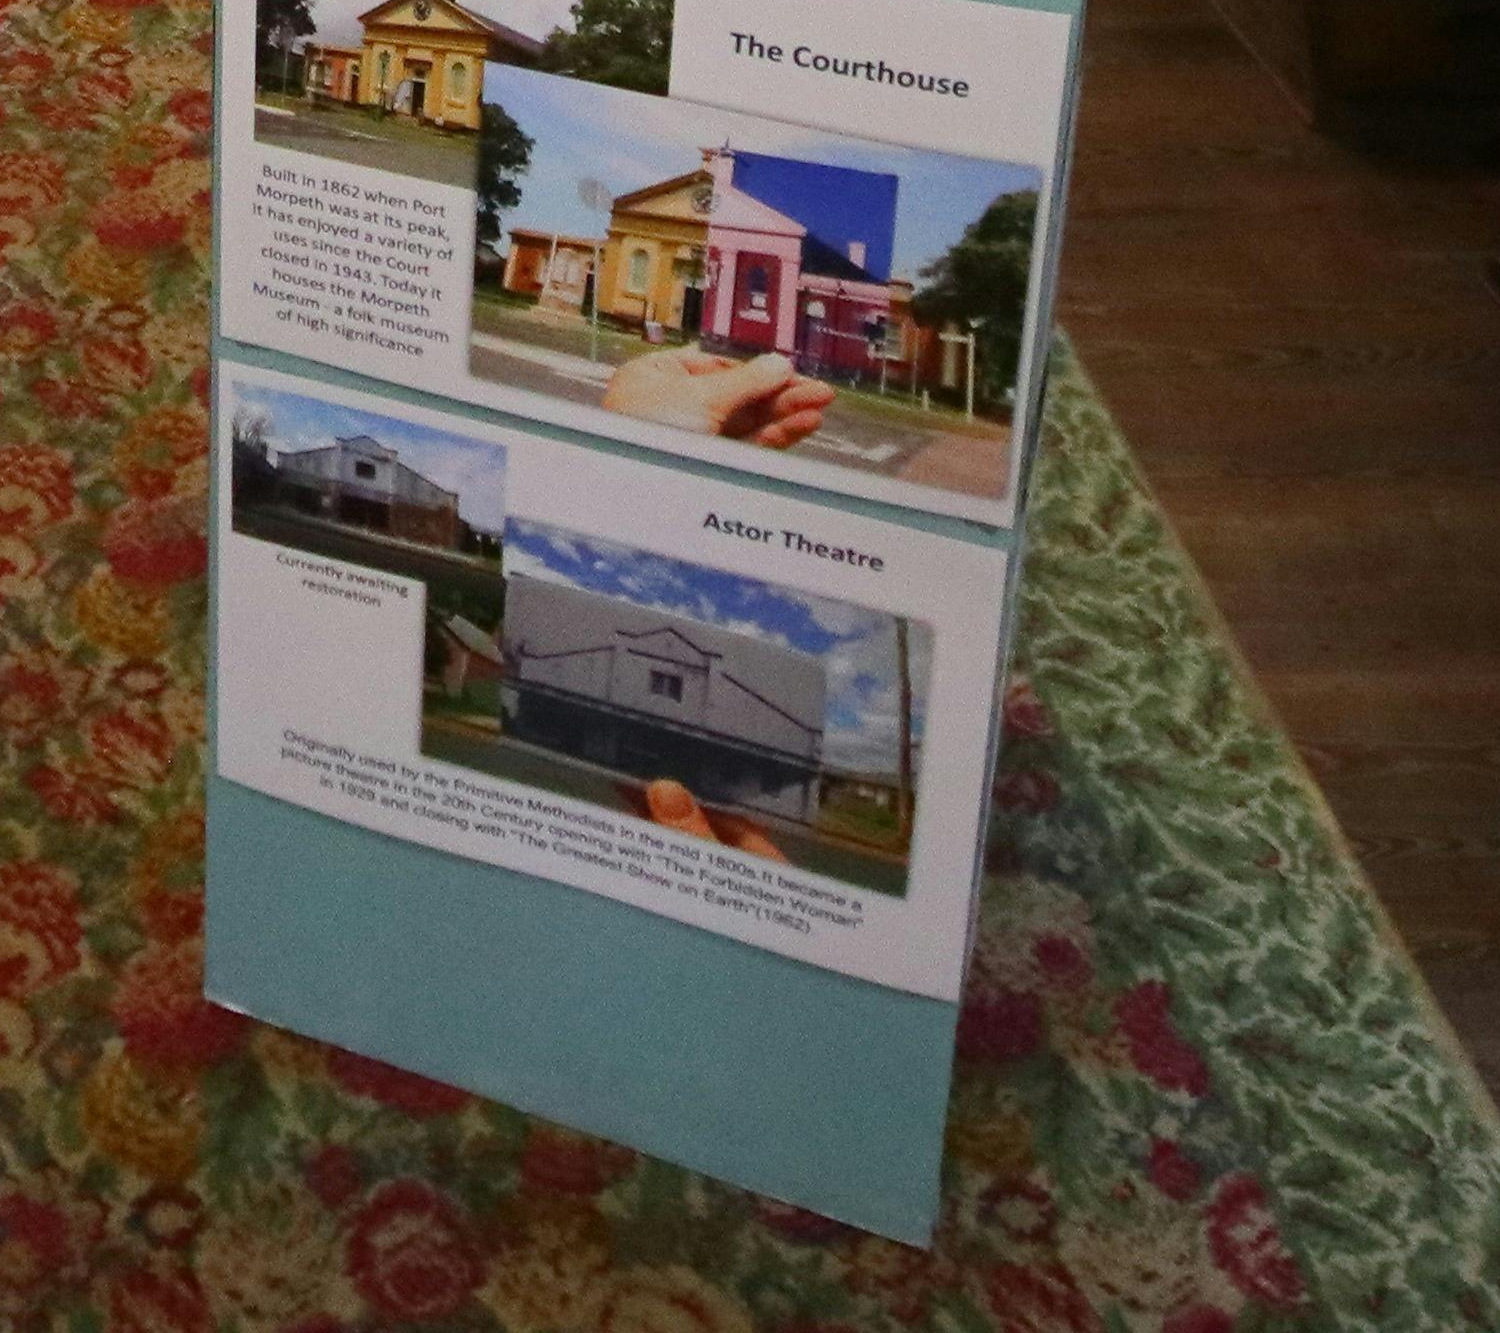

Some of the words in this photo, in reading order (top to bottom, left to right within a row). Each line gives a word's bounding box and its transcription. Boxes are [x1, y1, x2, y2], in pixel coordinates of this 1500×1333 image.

[730, 31, 783, 62] The
[792, 45, 969, 97] Courthouse
[255, 183, 324, 211] Morpeth
[328, 203, 359, 219] was
[362, 211, 379, 224] at
[383, 213, 402, 229] its
[406, 221, 449, 242] peak,
[261, 163, 297, 184] Built
[301, 174, 316, 188] in
[321, 178, 360, 199] 1862
[363, 190, 407, 209] when
[412, 198, 445, 218] Port
[252, 202, 262, 215] it
[266, 205, 293, 224] has
[296, 216, 359, 239] enjoyed
[363, 232, 373, 243] a
[377, 235, 433, 259] variety
[436, 248, 453, 261] of
[273, 230, 308, 247] uses
[311, 239, 350, 257] since
[355, 248, 382, 265] the
[385, 255, 429, 277] Court
[260, 246, 309, 267] closed
[313, 258, 328, 272] in
[333, 262, 376, 285] 1943.
[379, 273, 427, 299] Today
[430, 287, 441, 300] it
[271, 267, 326, 291] houses
[329, 282, 355, 299] the
[360, 289, 430, 317] Morpeth
[252, 281, 320, 309] Museum
[333, 305, 343, 316] a
[346, 305, 374, 324] folk
[379, 317, 449, 342] museum
[275, 309, 292, 321] of
[296, 312, 329, 332] high
[333, 324, 423, 356] significance
[702, 512, 773, 543] Astor
[781, 530, 884, 571] Theatre
[275, 552, 343, 580] Currently
[346, 572, 408, 598] awaiting
[301, 578, 381, 607] restoration
